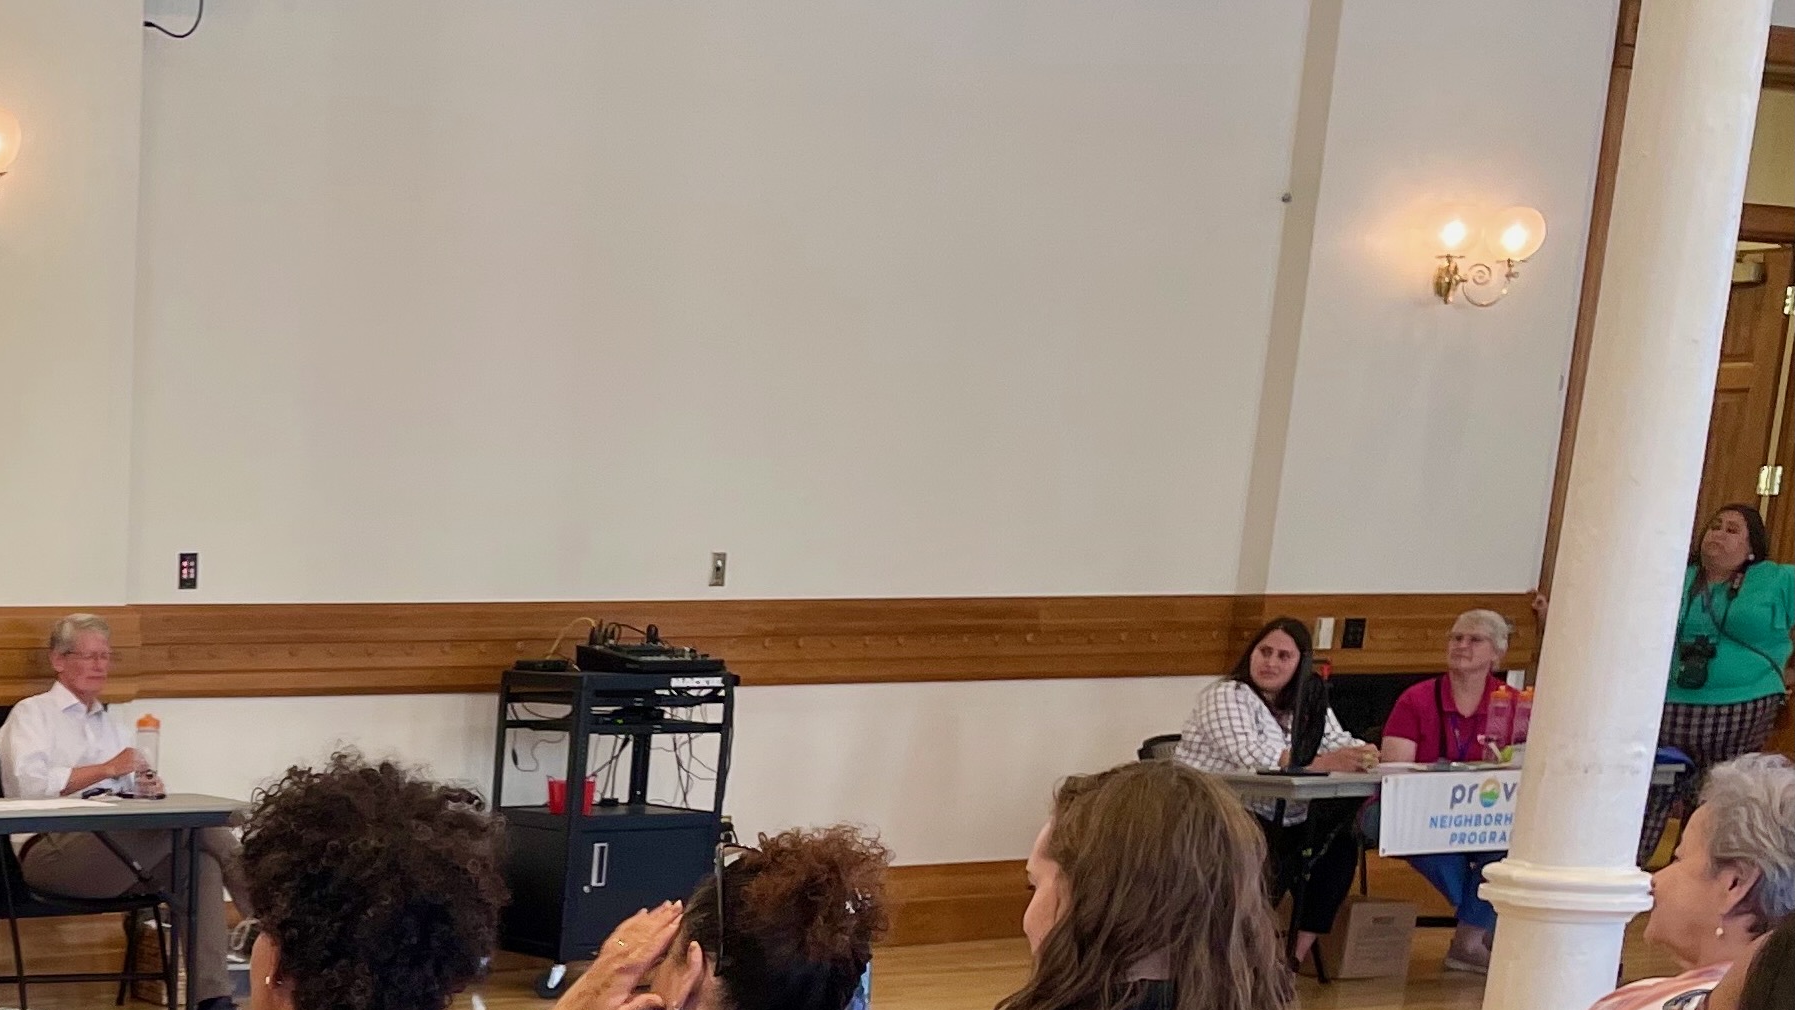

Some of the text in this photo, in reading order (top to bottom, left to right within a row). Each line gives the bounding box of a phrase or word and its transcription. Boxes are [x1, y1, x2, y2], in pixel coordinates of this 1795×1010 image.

[1449, 777, 1517, 809] prov
[1429, 813, 1513, 829] NEIGHBORH
[1449, 831, 1507, 845] PROGRA
